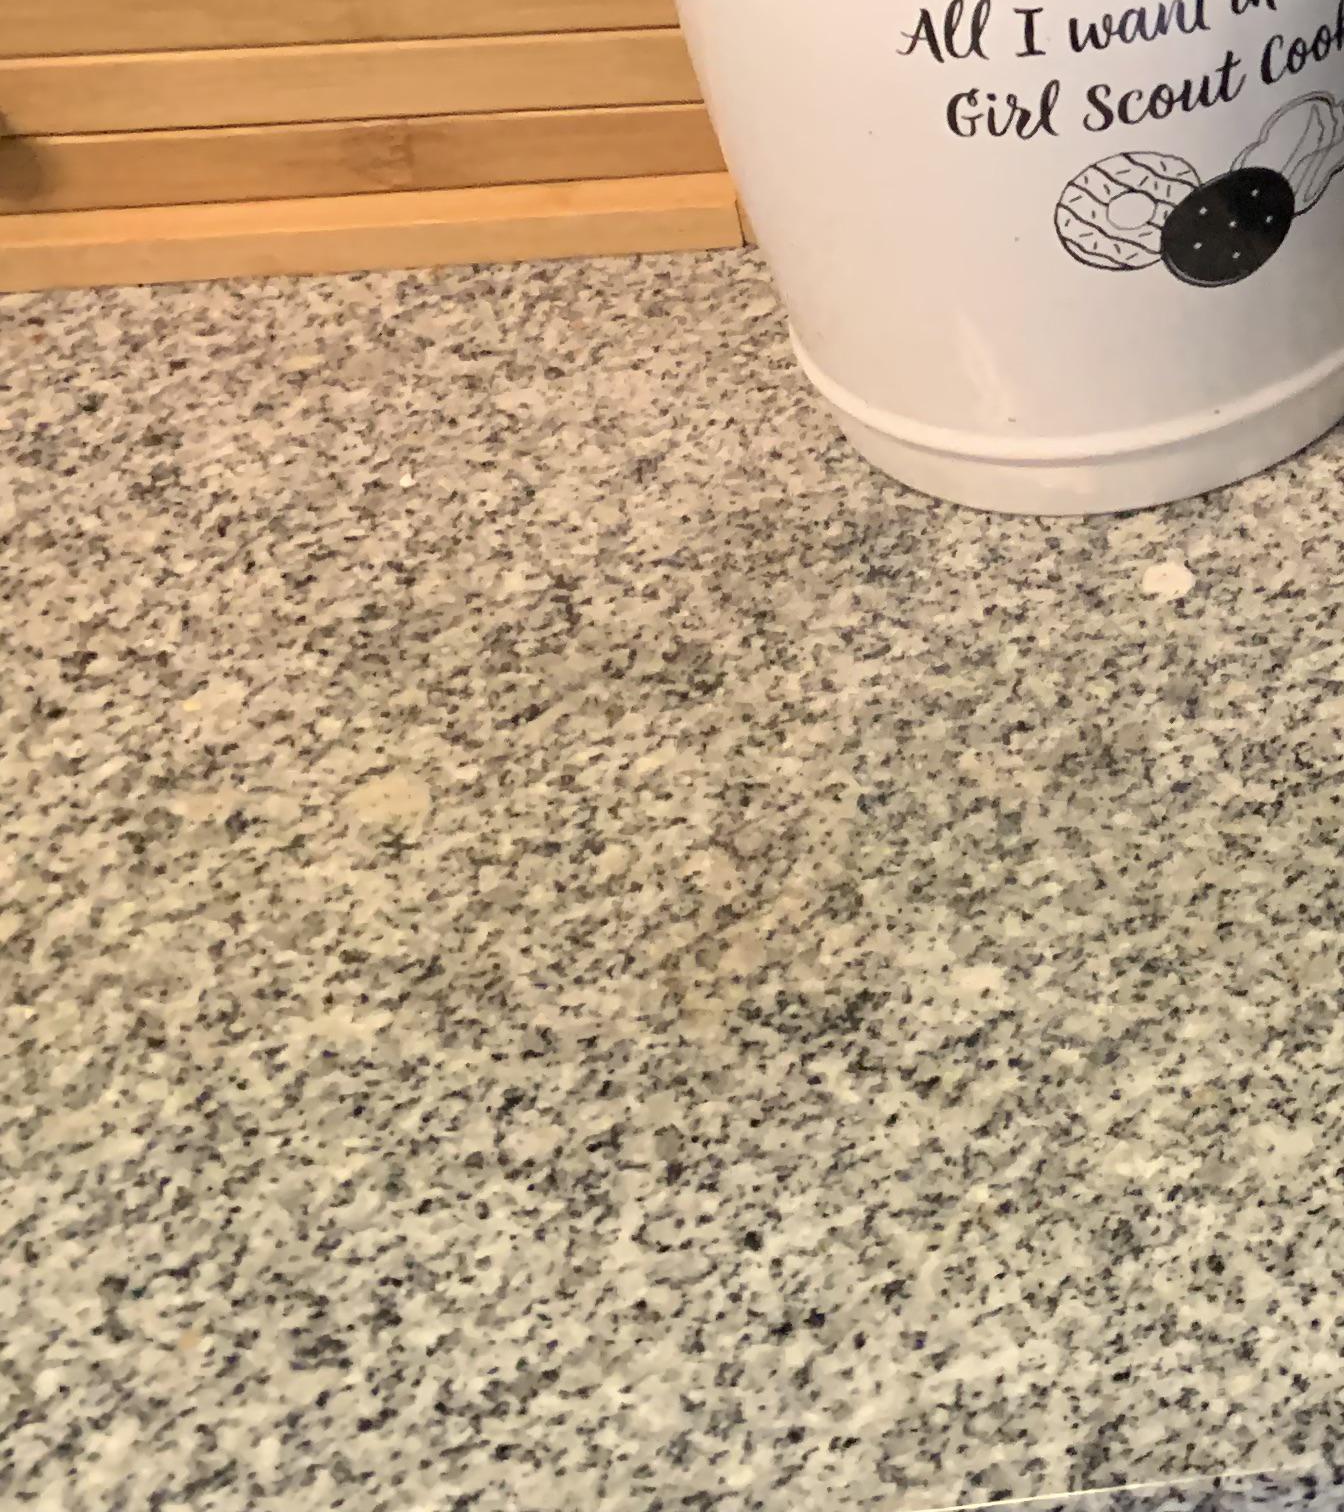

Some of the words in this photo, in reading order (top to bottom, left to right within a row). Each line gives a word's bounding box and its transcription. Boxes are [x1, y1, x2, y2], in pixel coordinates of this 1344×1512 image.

[1013, 7, 1044, 58] I
[945, 79, 1061, 140] Girl
[1082, 50, 1248, 133] Scout
